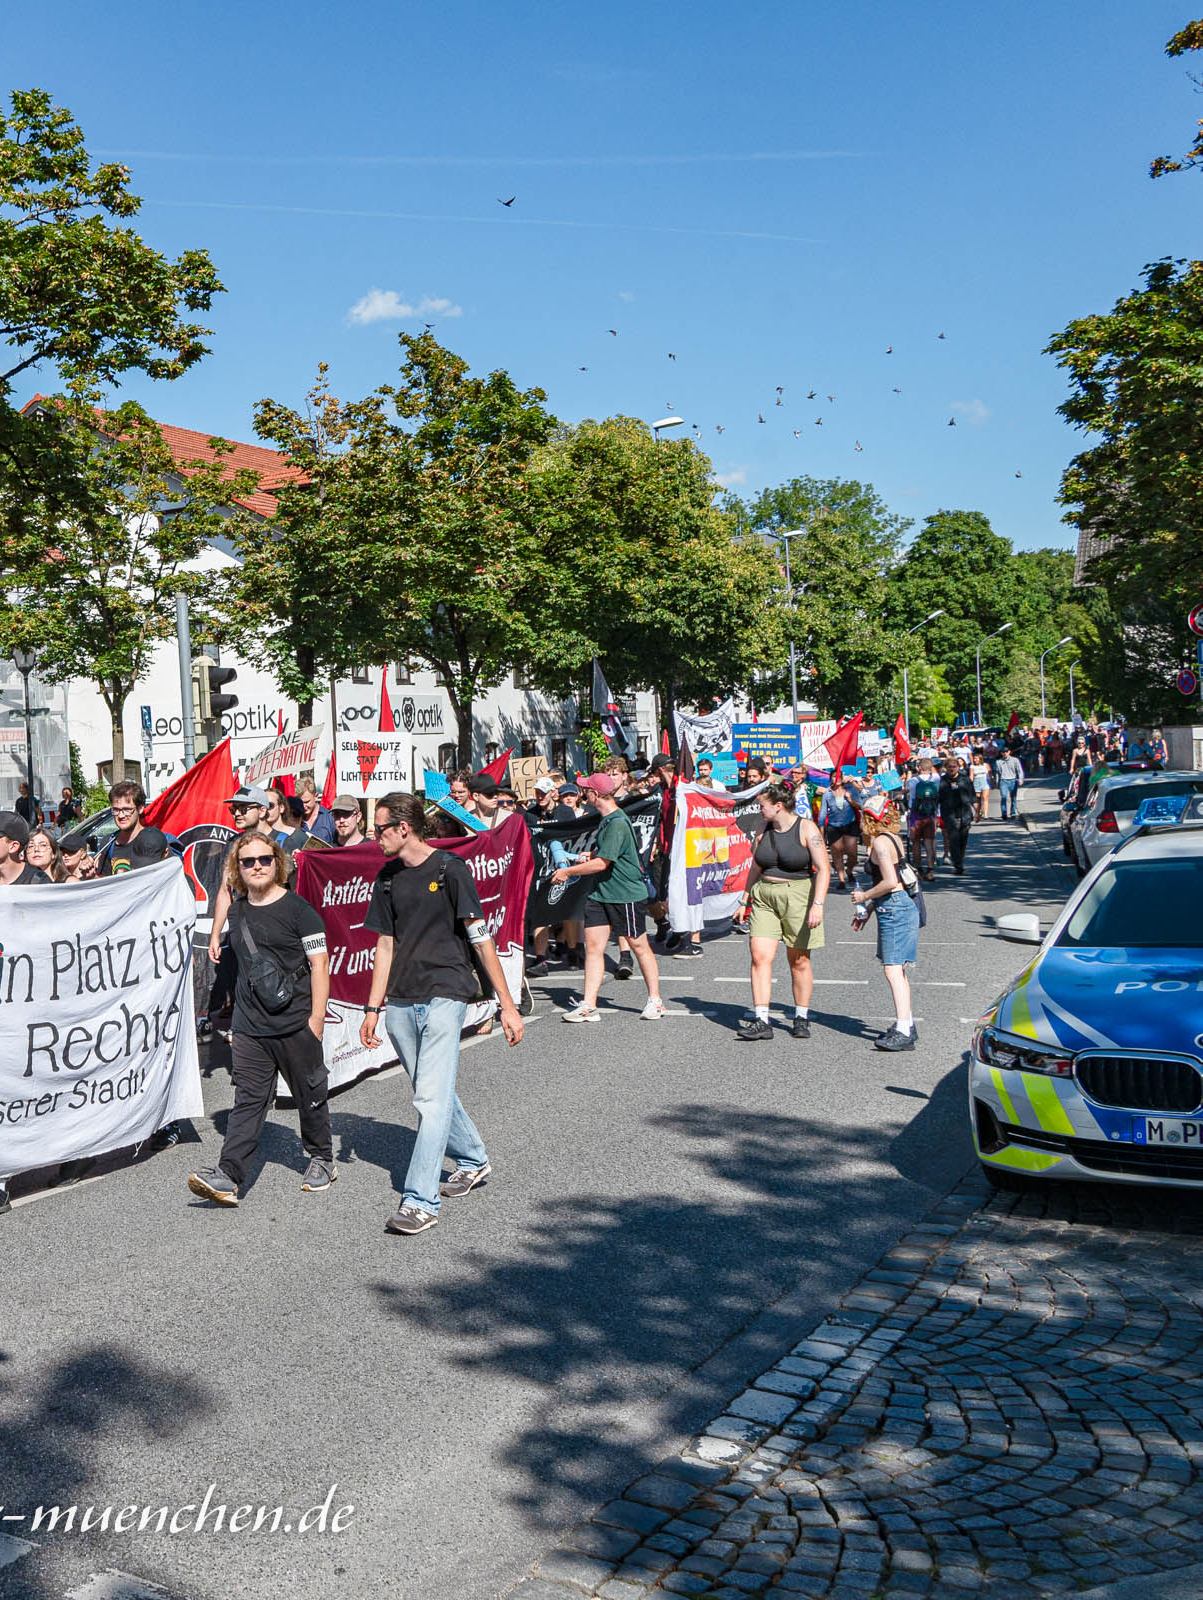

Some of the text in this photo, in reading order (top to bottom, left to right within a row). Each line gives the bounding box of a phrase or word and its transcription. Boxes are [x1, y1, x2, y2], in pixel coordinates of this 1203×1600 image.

[221, 703, 278, 736] optik
[417, 703, 443, 732] optik
[341, 741, 401, 752] SELBSTSCHUTZ
[244, 737, 319, 786] ALTERNATIVE
[356, 755, 380, 765] STATT
[511, 759, 544, 777] FCK
[341, 771, 407, 782] LICHTERKETTEN
[49, 932, 140, 1002] Platz
[149, 916, 197, 980] für
[67, 1067, 146, 1111] Stadt!
[1136, 1131, 1143, 1139] D
